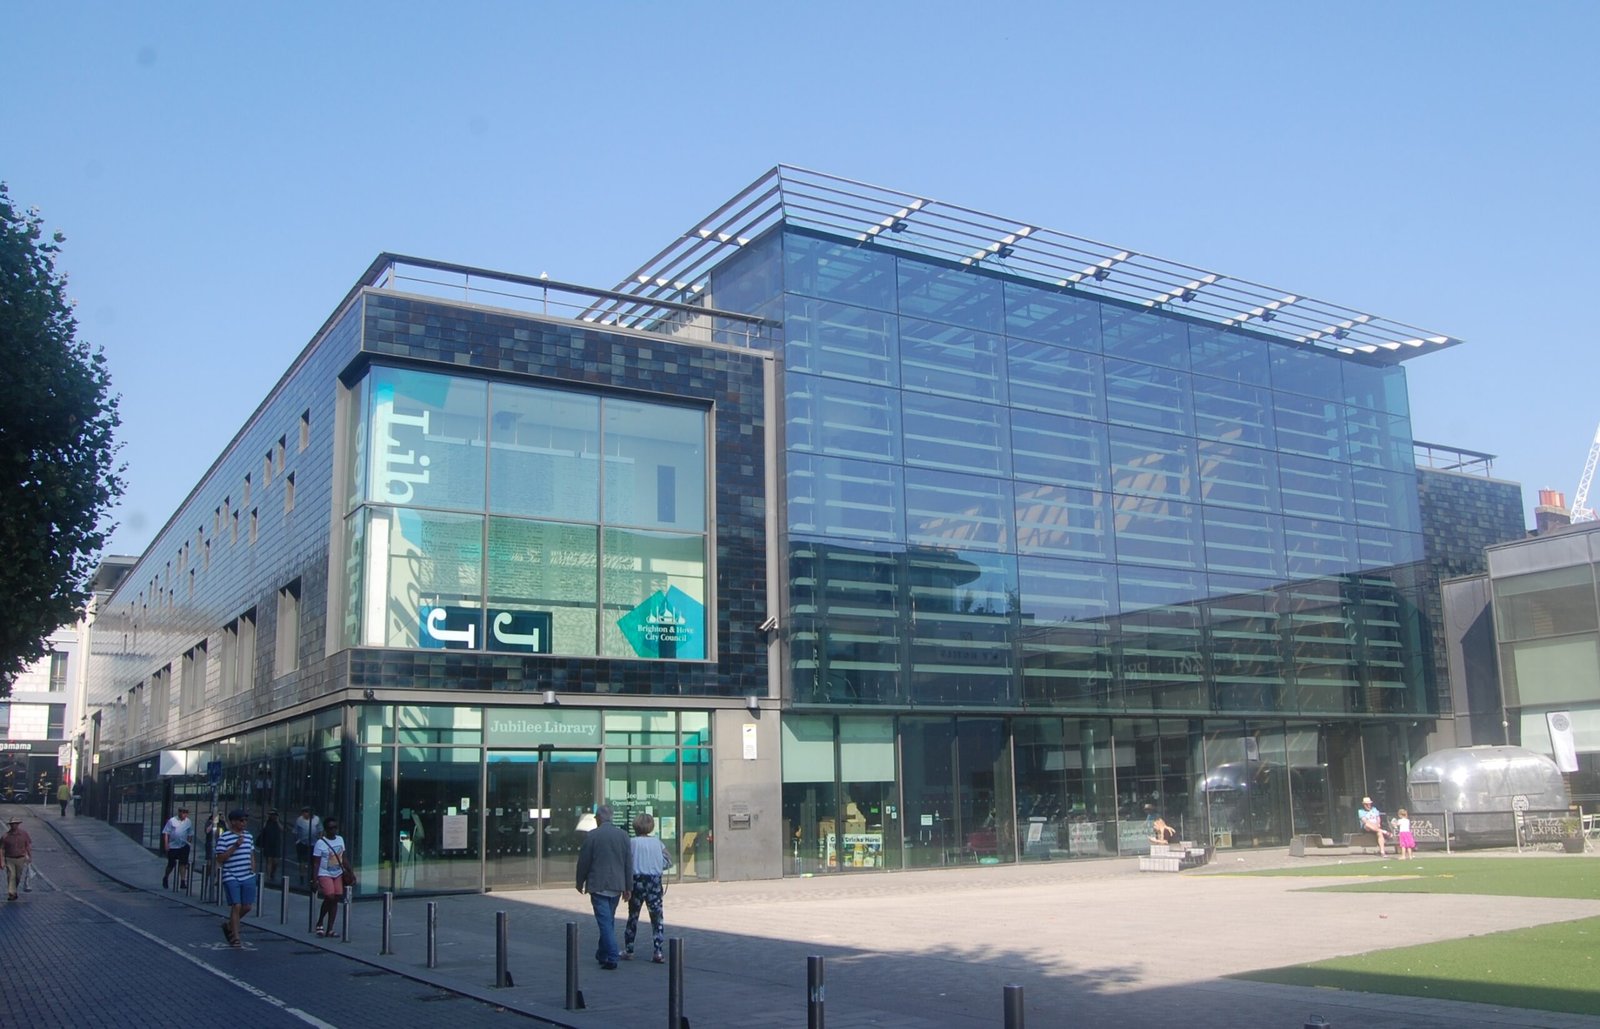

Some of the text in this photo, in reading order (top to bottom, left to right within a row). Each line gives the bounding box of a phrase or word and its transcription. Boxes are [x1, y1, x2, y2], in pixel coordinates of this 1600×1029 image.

[427, 608, 475, 649] J
[493, 612, 540, 652] J
[637, 625, 668, 633] Brighton
[660, 634, 687, 642] Council
[490, 720, 597, 736] Jubilee Library
[1393, 828, 1440, 837] ERESS
[1531, 826, 1565, 835] EXPRE
